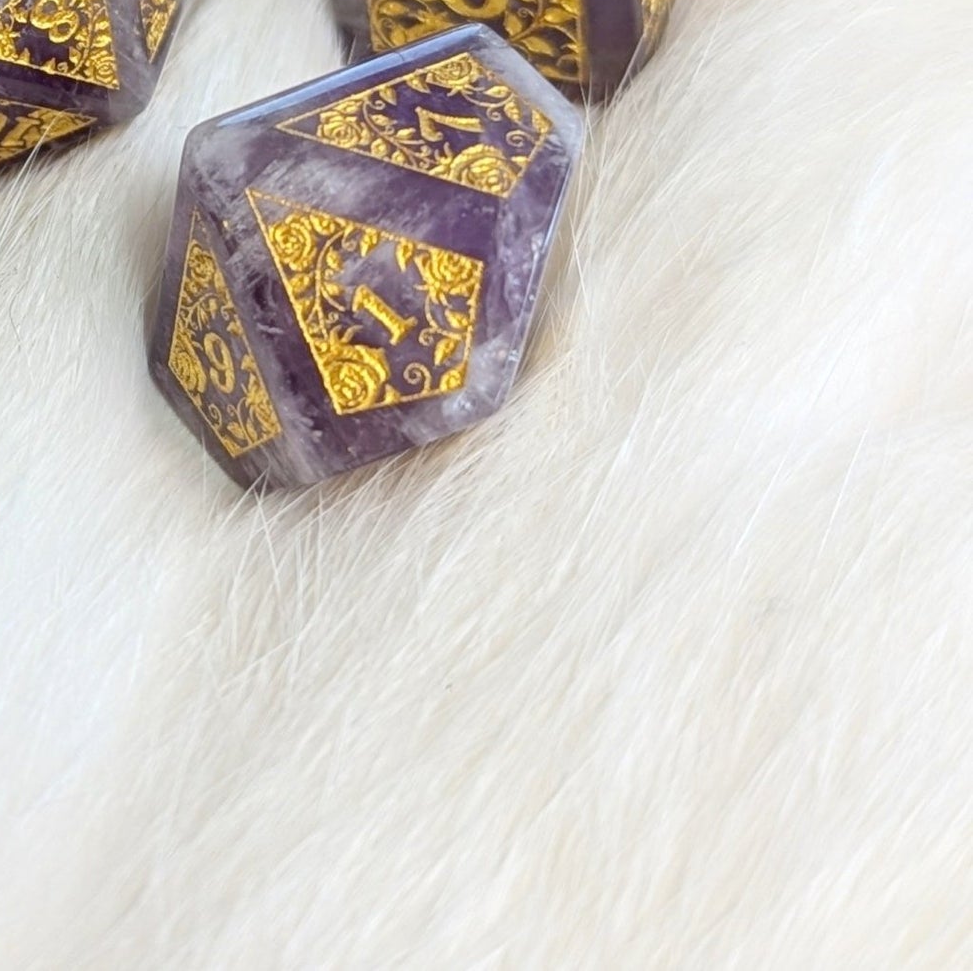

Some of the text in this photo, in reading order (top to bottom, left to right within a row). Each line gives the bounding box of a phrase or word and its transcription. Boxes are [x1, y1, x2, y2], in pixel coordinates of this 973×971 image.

[414, 106, 484, 142] 7
[353, 285, 416, 345] 1
[203, 331, 234, 394] 9
